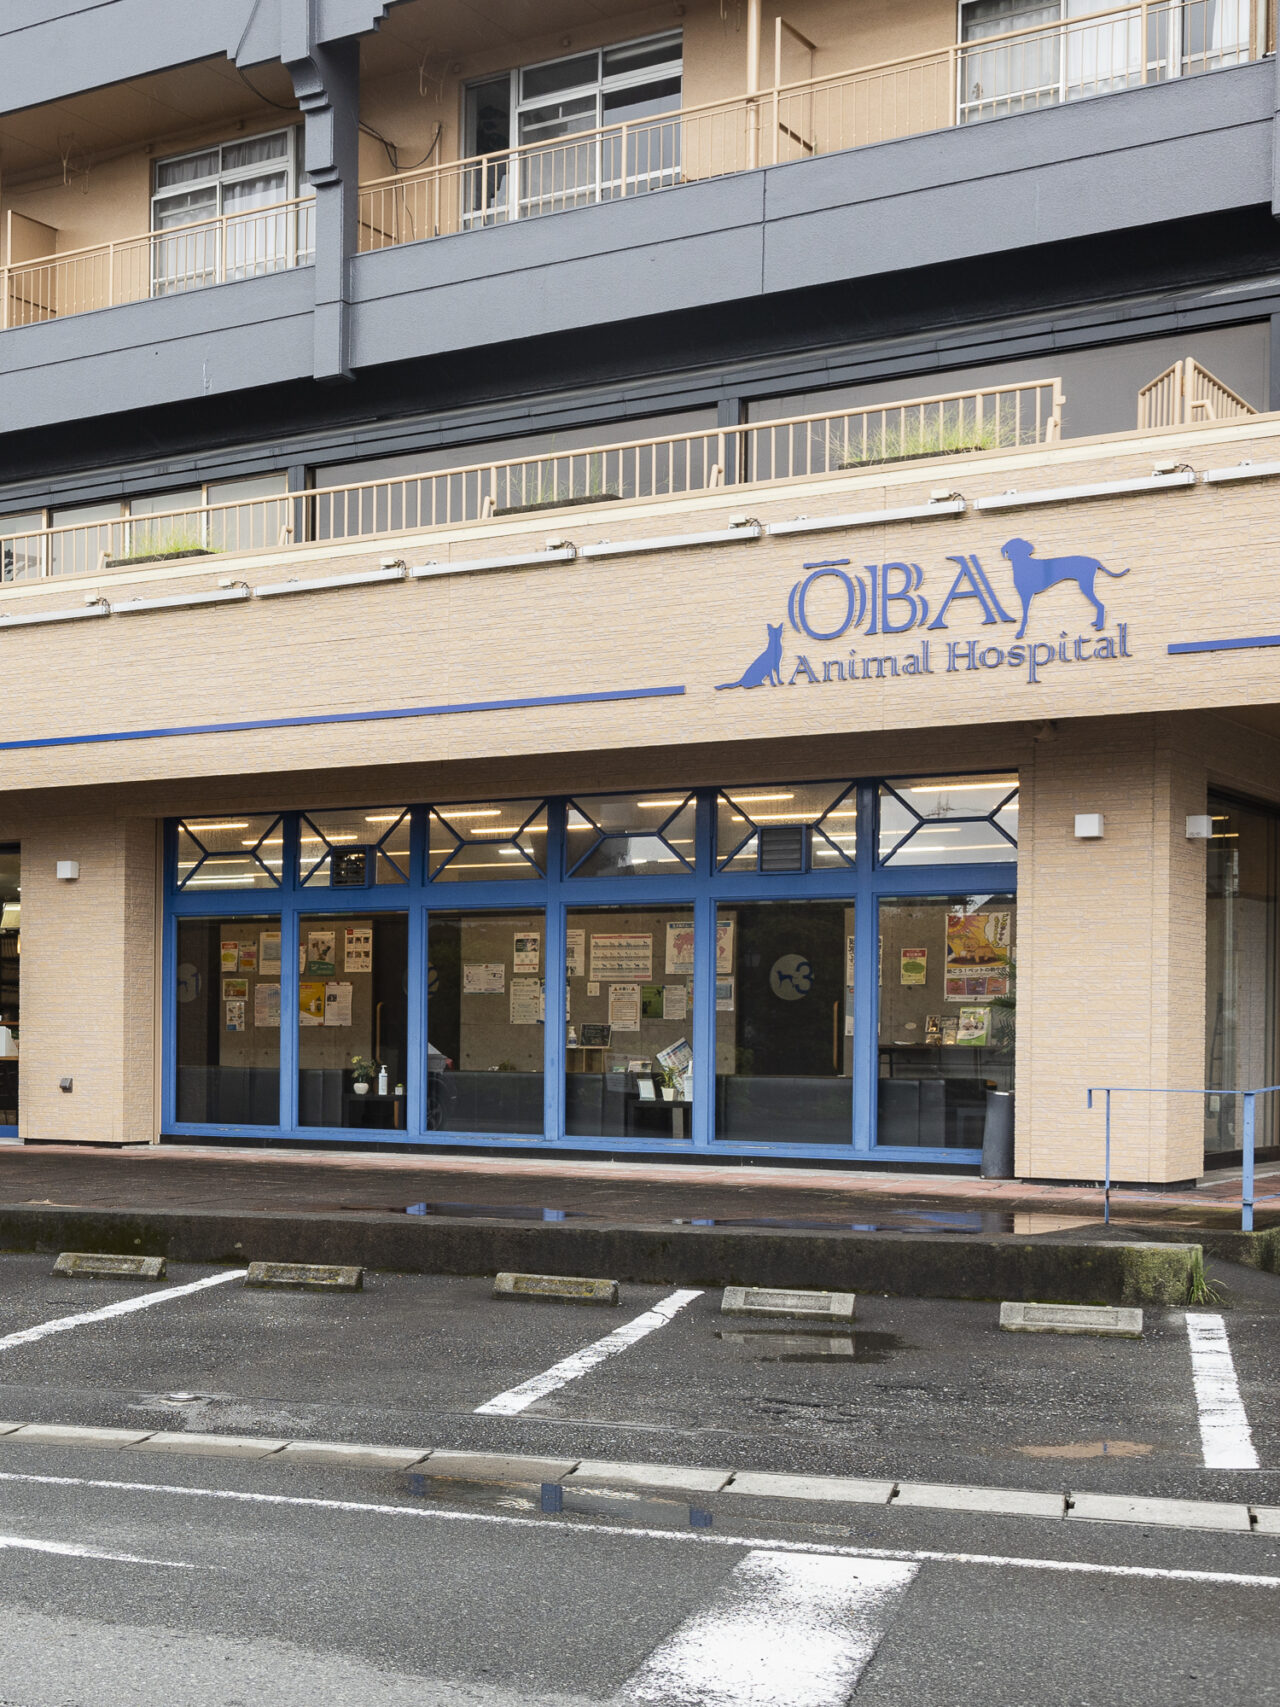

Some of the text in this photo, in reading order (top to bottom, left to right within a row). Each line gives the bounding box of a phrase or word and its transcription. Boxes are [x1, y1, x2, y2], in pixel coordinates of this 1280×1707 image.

[788, 622, 1133, 686] Animal Hospital
[794, 961, 815, 995] 3
